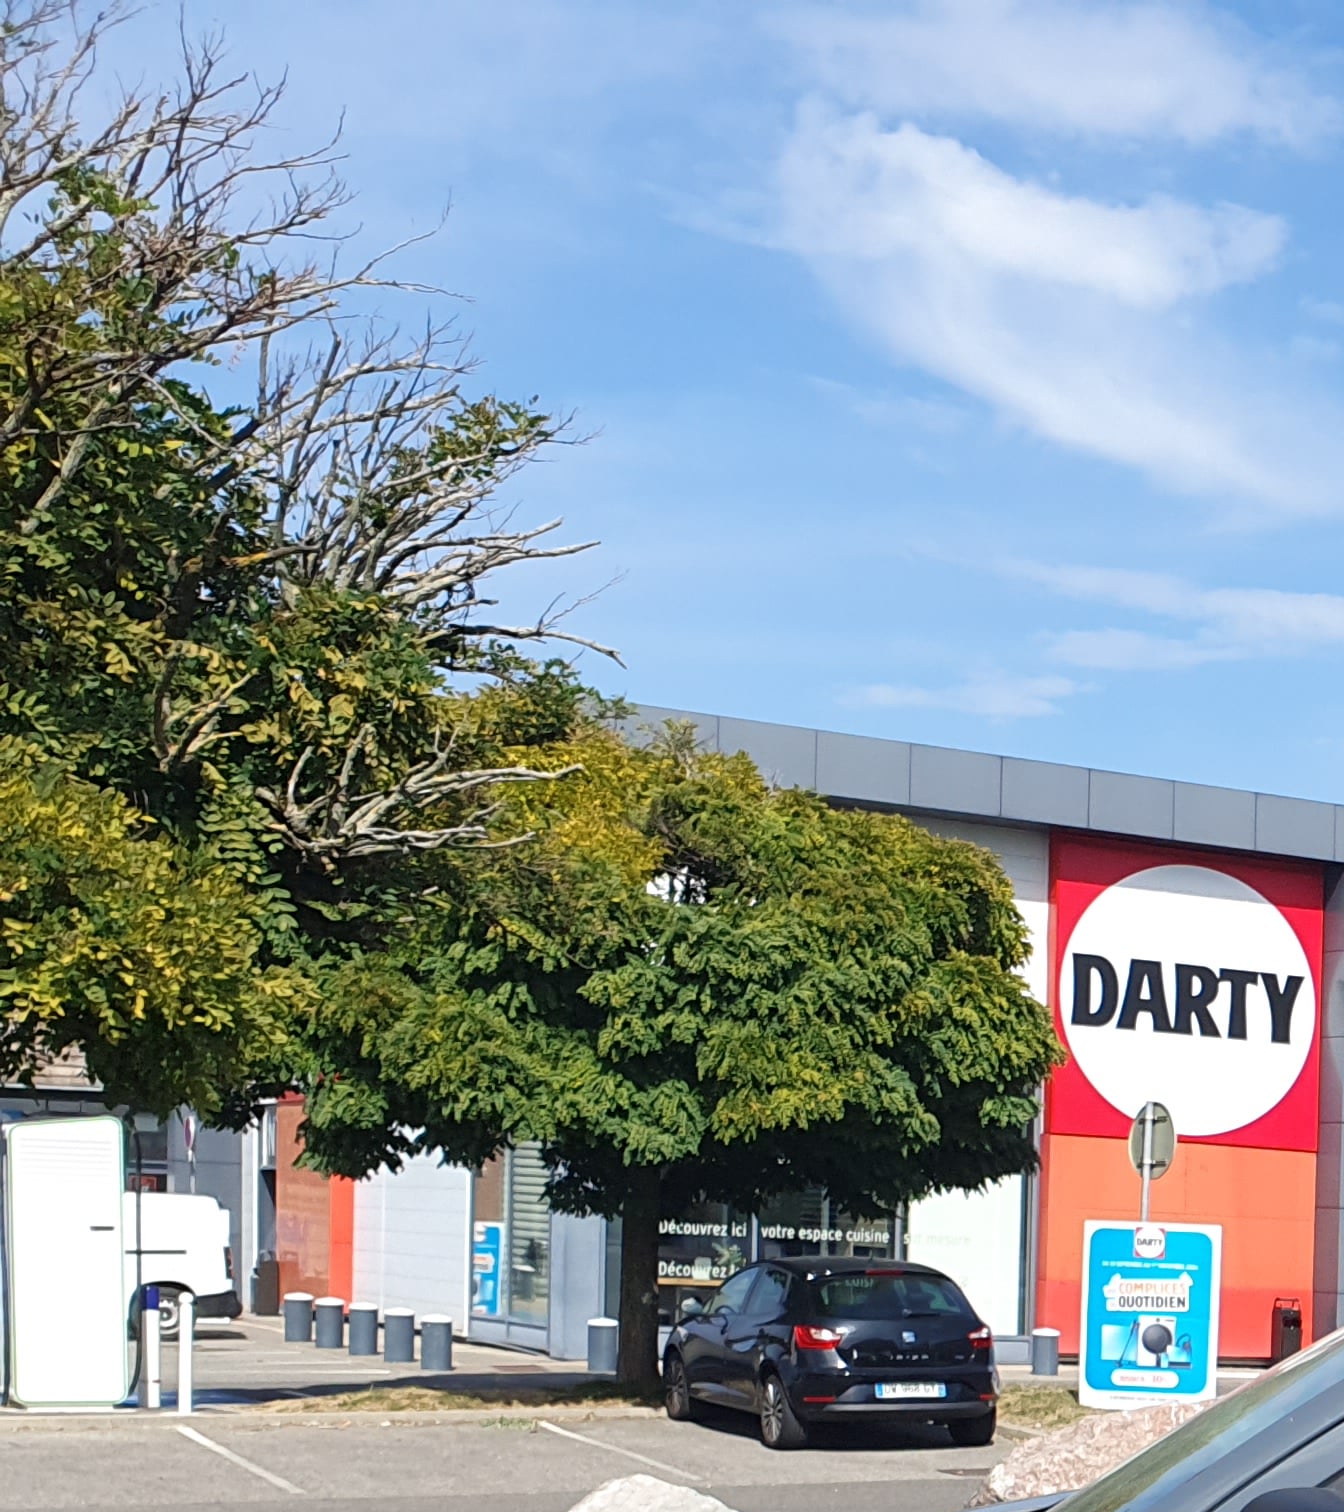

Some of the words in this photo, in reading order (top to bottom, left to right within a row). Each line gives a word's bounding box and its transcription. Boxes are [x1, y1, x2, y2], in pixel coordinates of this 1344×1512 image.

[1071, 952, 1305, 1045] DARTY
[659, 1218, 728, 1237] Découvrez
[731, 1220, 747, 1238] ici
[761, 1224, 795, 1240] votre
[798, 1225, 843, 1243] espace
[845, 1228, 890, 1244] cuisine
[1136, 1238, 1163, 1247] DARTY
[1118, 1282, 1186, 1296] COMPLICES
[1118, 1295, 1186, 1309] QUOTIDIEN
